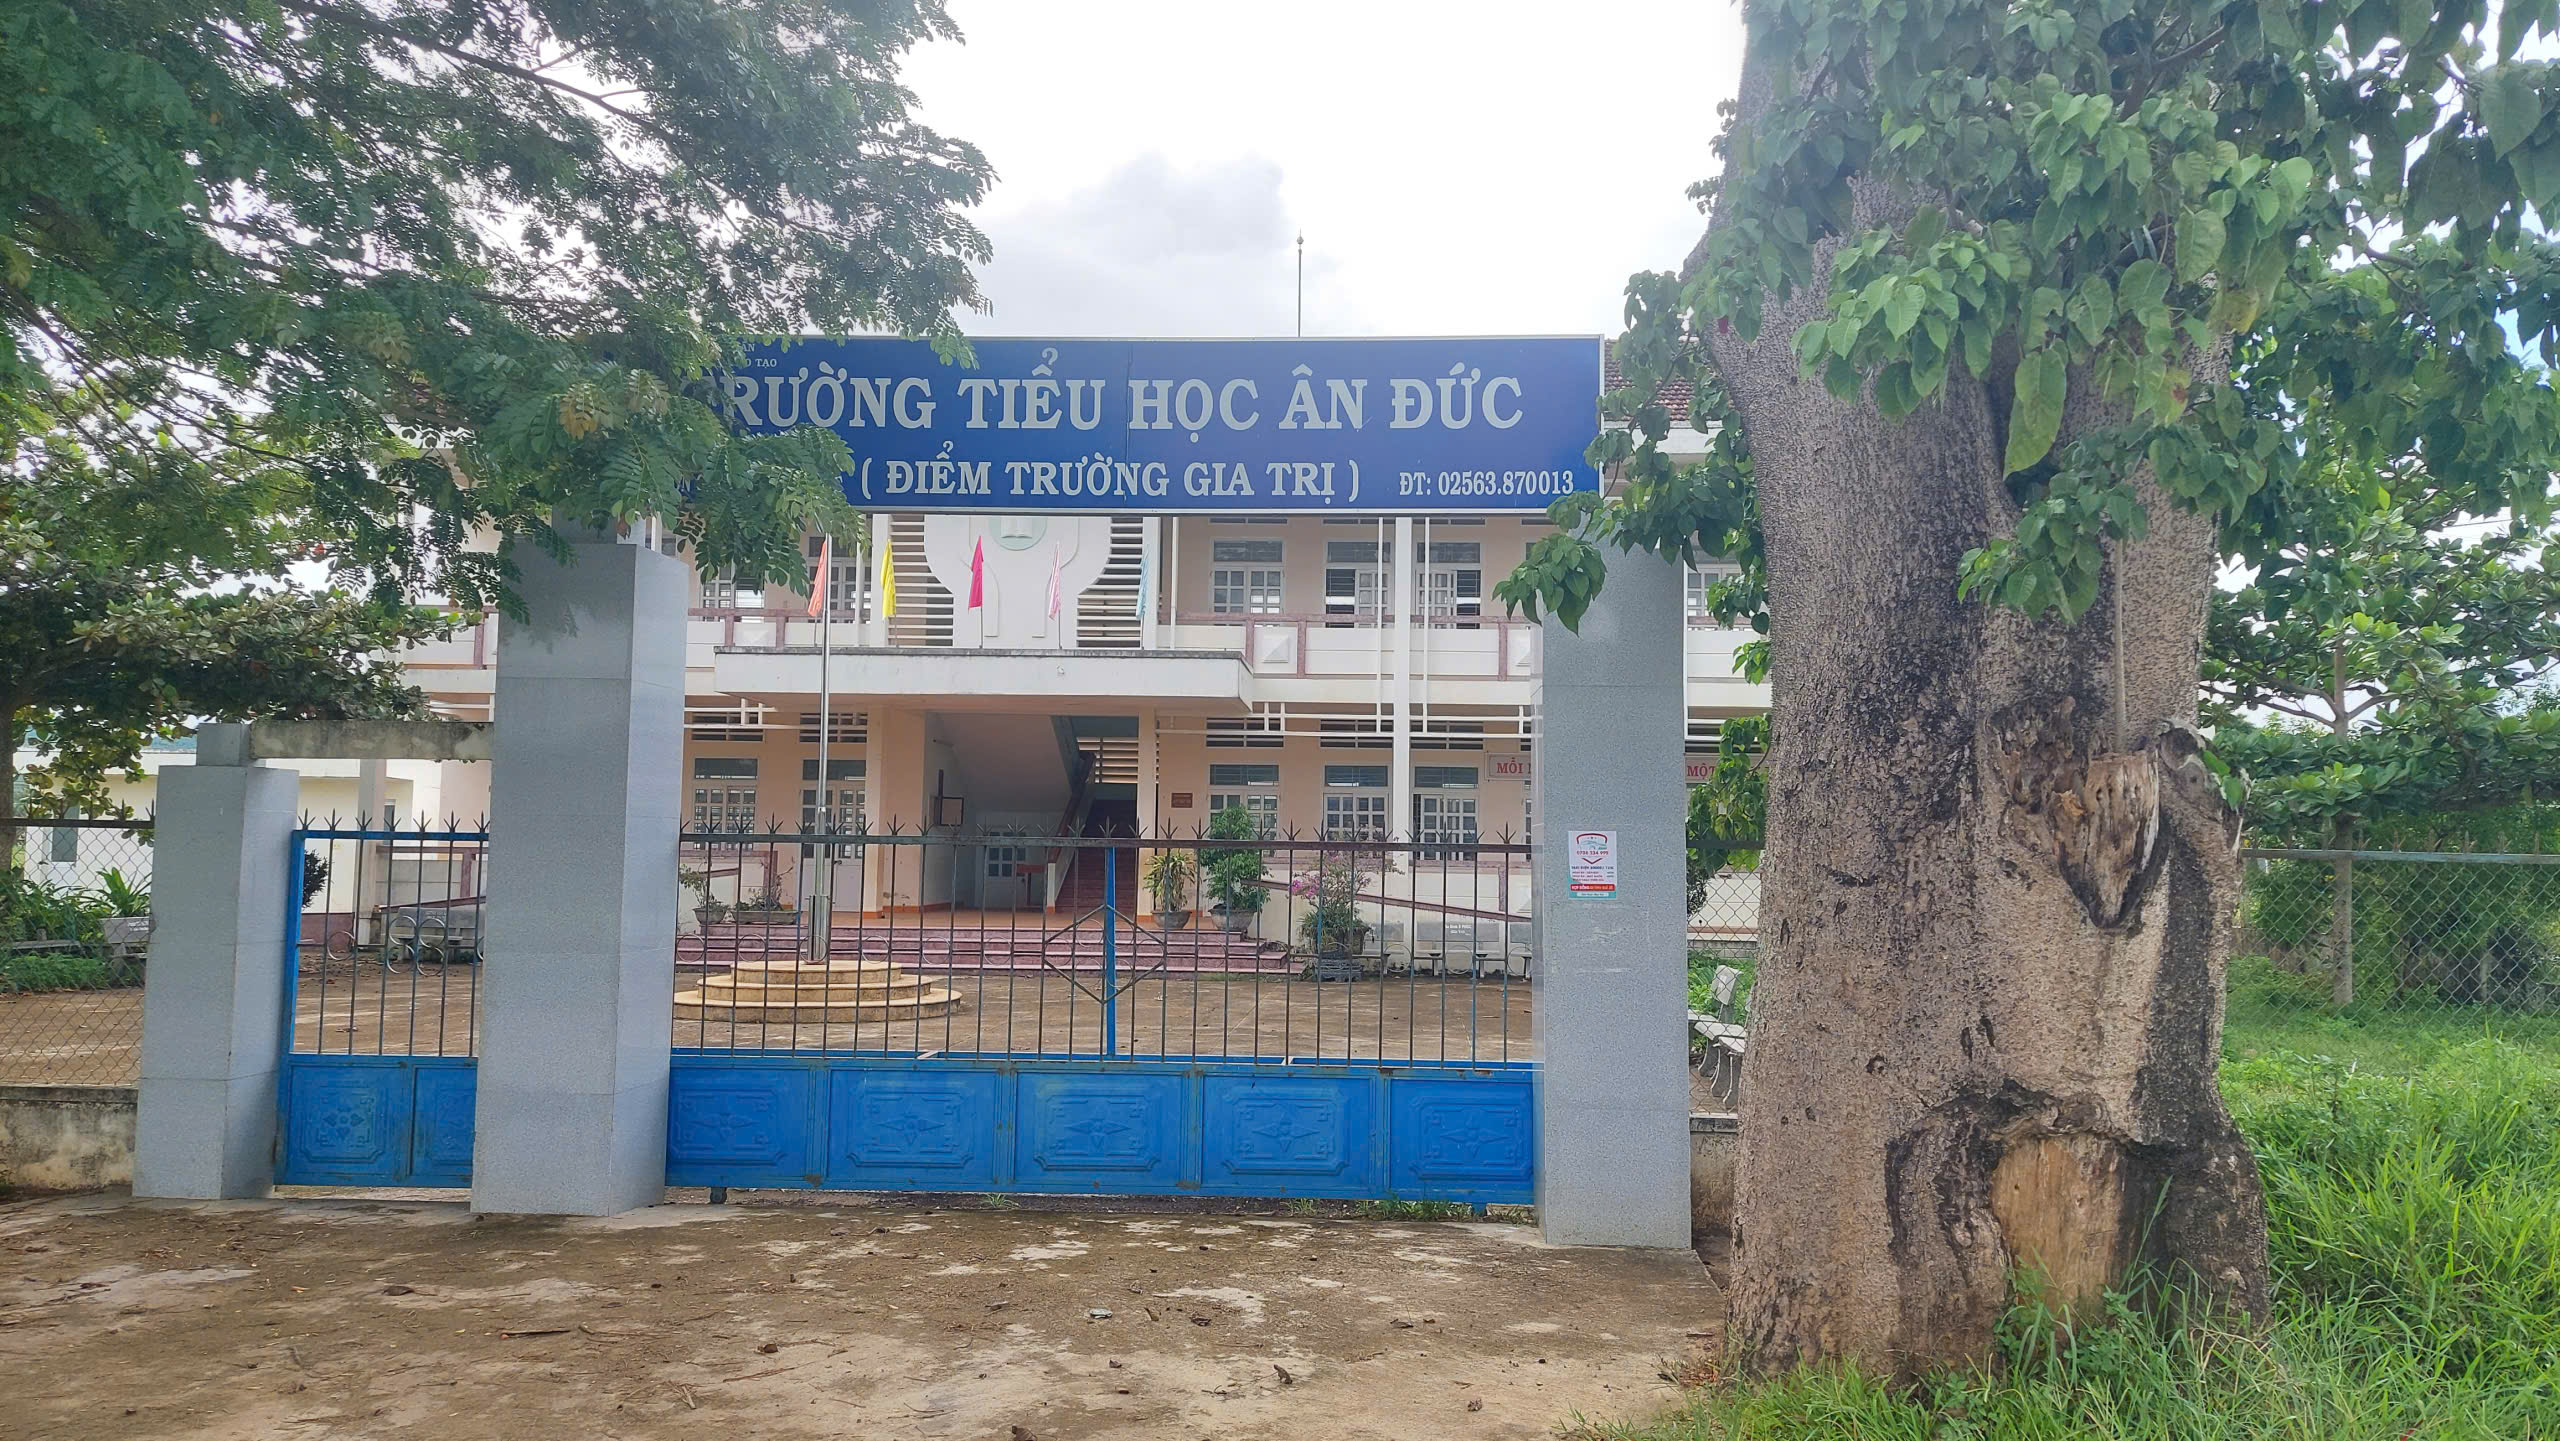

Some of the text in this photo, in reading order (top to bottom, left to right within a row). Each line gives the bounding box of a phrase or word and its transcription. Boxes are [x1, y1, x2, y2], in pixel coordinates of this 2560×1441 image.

[755, 358, 777, 368] TẠO
[957, 347, 1105, 430] TIỂU
[1128, 376, 1260, 443] HỌC
[1278, 363, 1368, 430] ÂN
[1389, 361, 1524, 430] ĐỨC
[886, 441, 992, 495] ĐIỂM
[1005, 451, 1169, 496] TRƯỜNG
[1184, 462, 1255, 496] GIA
[1266, 462, 1336, 505] TRỊ
[1399, 469, 1575, 496] ĐT: 02563.870013
